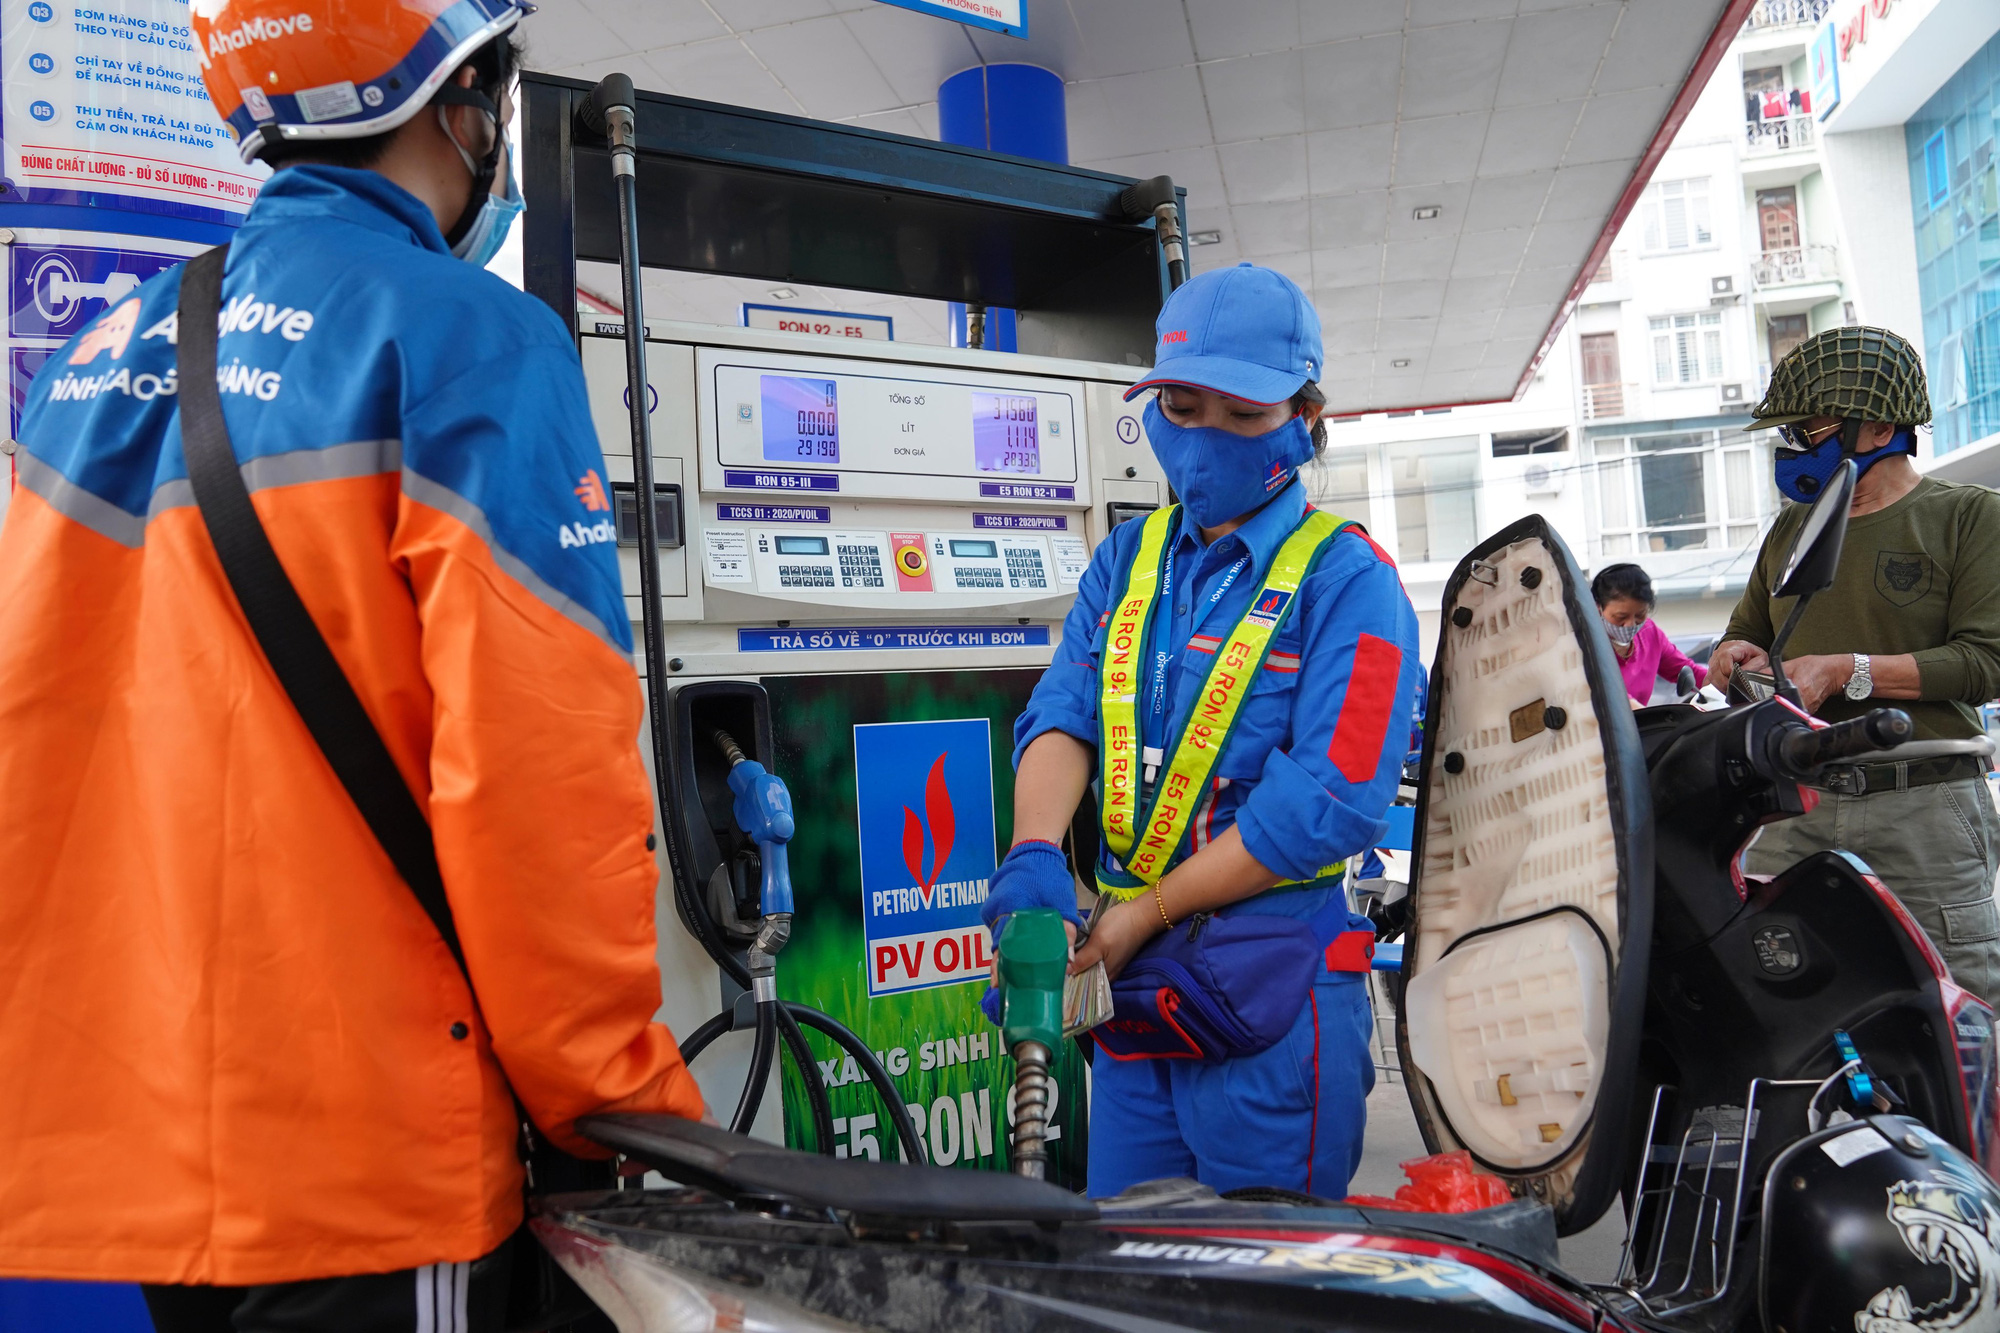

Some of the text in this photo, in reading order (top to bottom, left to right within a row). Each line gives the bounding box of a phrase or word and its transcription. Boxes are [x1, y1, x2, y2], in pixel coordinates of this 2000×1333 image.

[32, 6, 49, 18] 03
[75, 8, 190, 38] BƠM HÀNG ĐỦ SỐ
[75, 22, 107, 35] THEO
[111, 27, 134, 40] YÊU
[138, 30, 165, 46] CẦU
[208, 13, 314, 58] AhaMove
[33, 57, 50, 69] 04
[75, 54, 99, 67] CHỈ
[102, 58, 124, 70] TAY
[127, 60, 143, 73] VỀ
[146, 63, 185, 81] ĐỒNG
[75, 66, 91, 80] ĐỂ
[95, 69, 142, 88] KHÁCH
[145, 79, 182, 95] HÀNG
[33, 105, 51, 117] 05
[76, 105, 102, 117] THU
[105, 107, 138, 123] TIỀN,
[141, 113, 166, 126] TRẢ
[170, 118, 190, 131] LẠI
[194, 121, 212, 135] ĐỦ
[76, 118, 214, 149] CẢM ƠN KHÁCH HÀNG
[21, 154, 53, 170] ĐÚNG
[56, 156, 85, 174] CHẤT
[88, 160, 126, 178] LƯỢNG
[136, 164, 152, 181] ĐỦ
[155, 168, 170, 183] SỐ
[172, 172, 208, 190] LƯỢNG
[217, 180, 245, 198] PHỤC
[597, 322, 649, 337] TATS
[779, 320, 810, 334] RON
[814, 323, 831, 335] 92
[825, 383, 834, 407] 0
[914, 394, 926, 406] SỐ
[993, 397, 1034, 423] 31560
[901, 421, 915, 433] LÍT
[1125, 422, 1132, 436] 7
[797, 439, 836, 457] 29190
[893, 447, 926, 457] ĐƠN GIÁ
[1003, 451, 1037, 468] 28330
[755, 475, 812, 488] RON 95-III
[999, 485, 1057, 498] E5 RON 92-II
[730, 506, 752, 518] TCCS
[754, 508, 764, 518] 01
[772, 508, 819, 520] 2020/PVOIL
[983, 515, 1002, 526] TCCS
[1003, 516, 1013, 526] 01
[1018, 517, 1057, 528] 2020/PVOIL
[1123, 599, 1144, 617] E5
[1247, 616, 1271, 628] PVOIL
[770, 631, 805, 649] TRẢ
[809, 630, 834, 648] SỐ
[837, 630, 860, 647] VỀ
[897, 630, 954, 646] TRƯỚC
[958, 633, 984, 645] KHI
[991, 631, 1025, 645] BƠM
[1113, 622, 1135, 665] RON
[1188, 640, 1251, 751] E5 RON 92
[1108, 725, 1128, 837] E5 RON 92
[1133, 772, 1191, 876] E5 RON 92
[872, 878, 989, 917] PETROVIETNAM
[875, 932, 993, 984] PV OIL
[1956, 1024, 1992, 1039] HONDA
[919, 1032, 990, 1071] SINH
